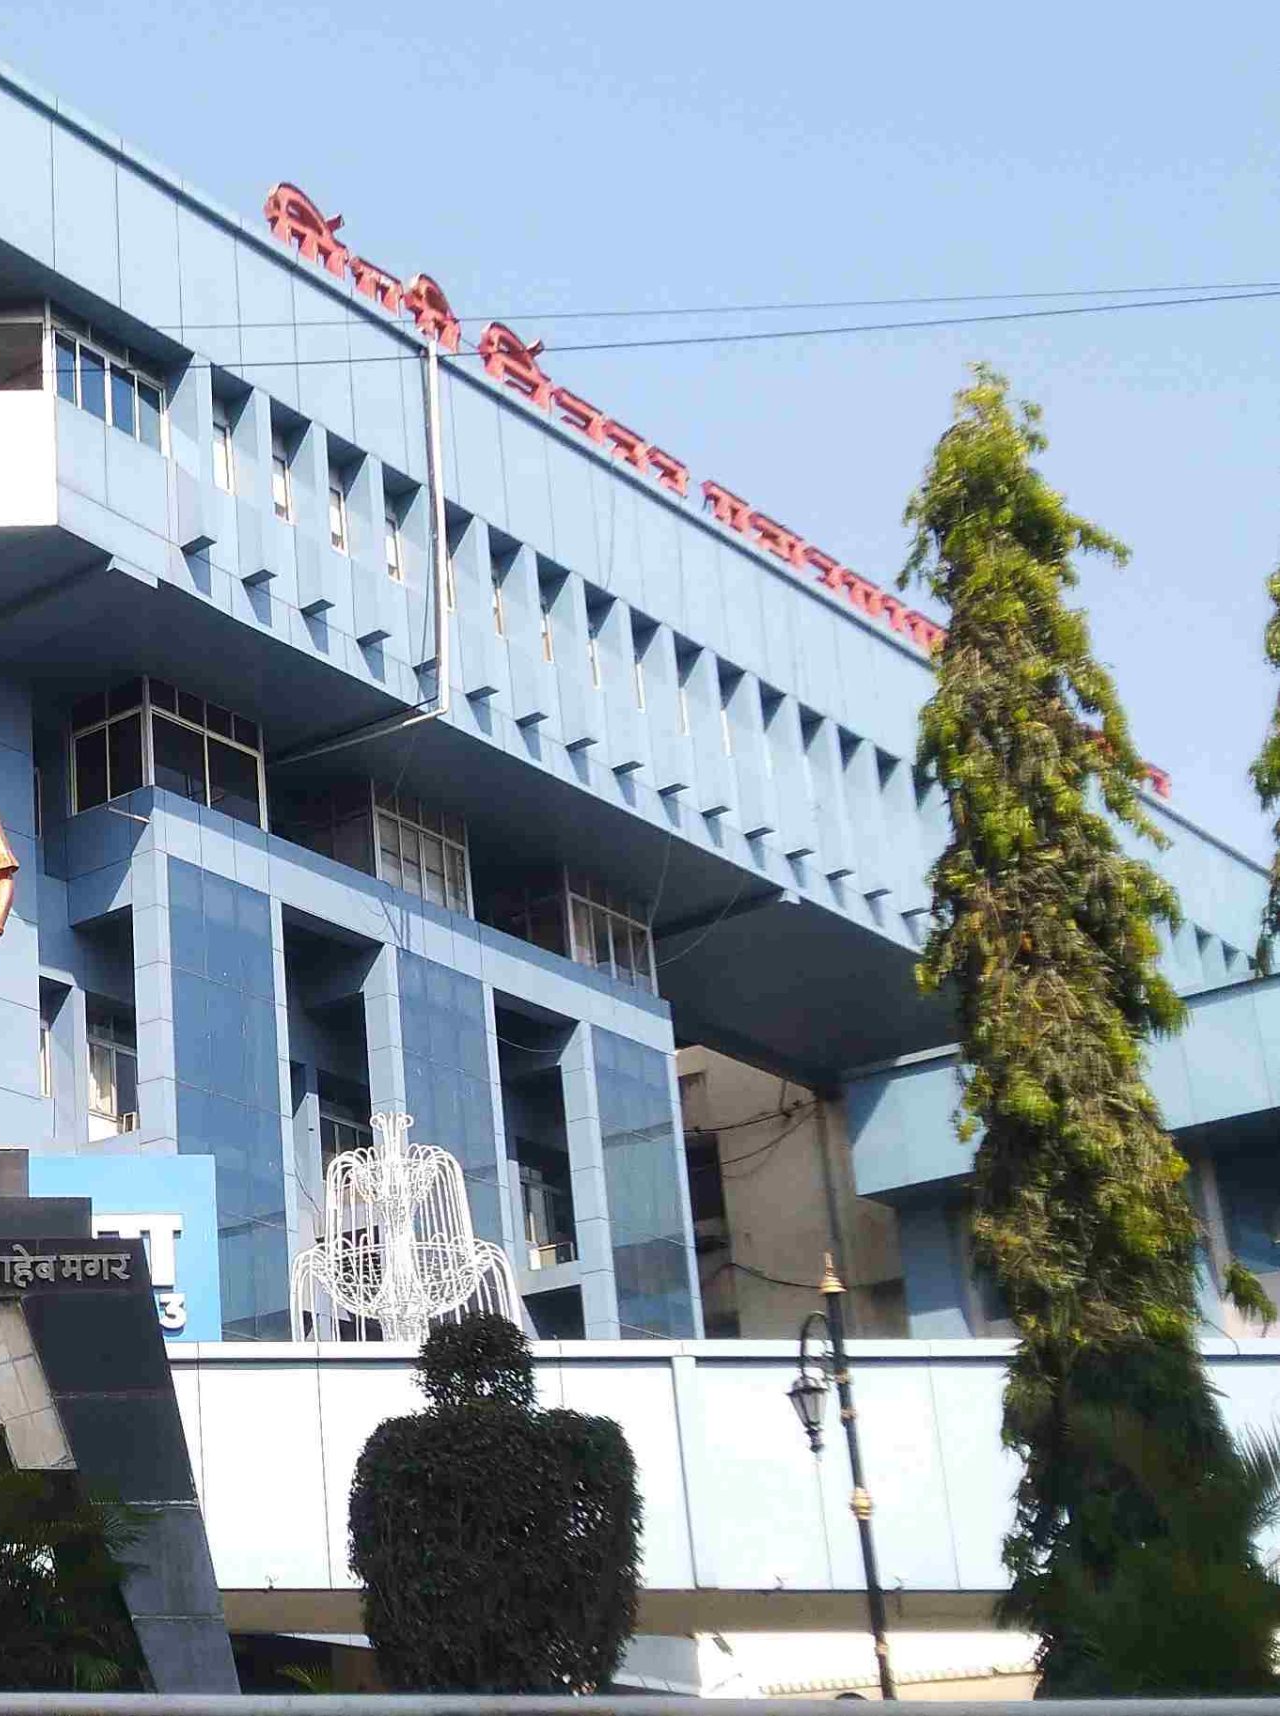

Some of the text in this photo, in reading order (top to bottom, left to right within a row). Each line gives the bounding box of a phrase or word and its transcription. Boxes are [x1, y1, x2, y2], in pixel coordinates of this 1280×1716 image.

[263, 181, 461, 354] पिंपरी
[477, 321, 690, 497] चिंचवड
[59, 1253, 131, 1281] मगर
